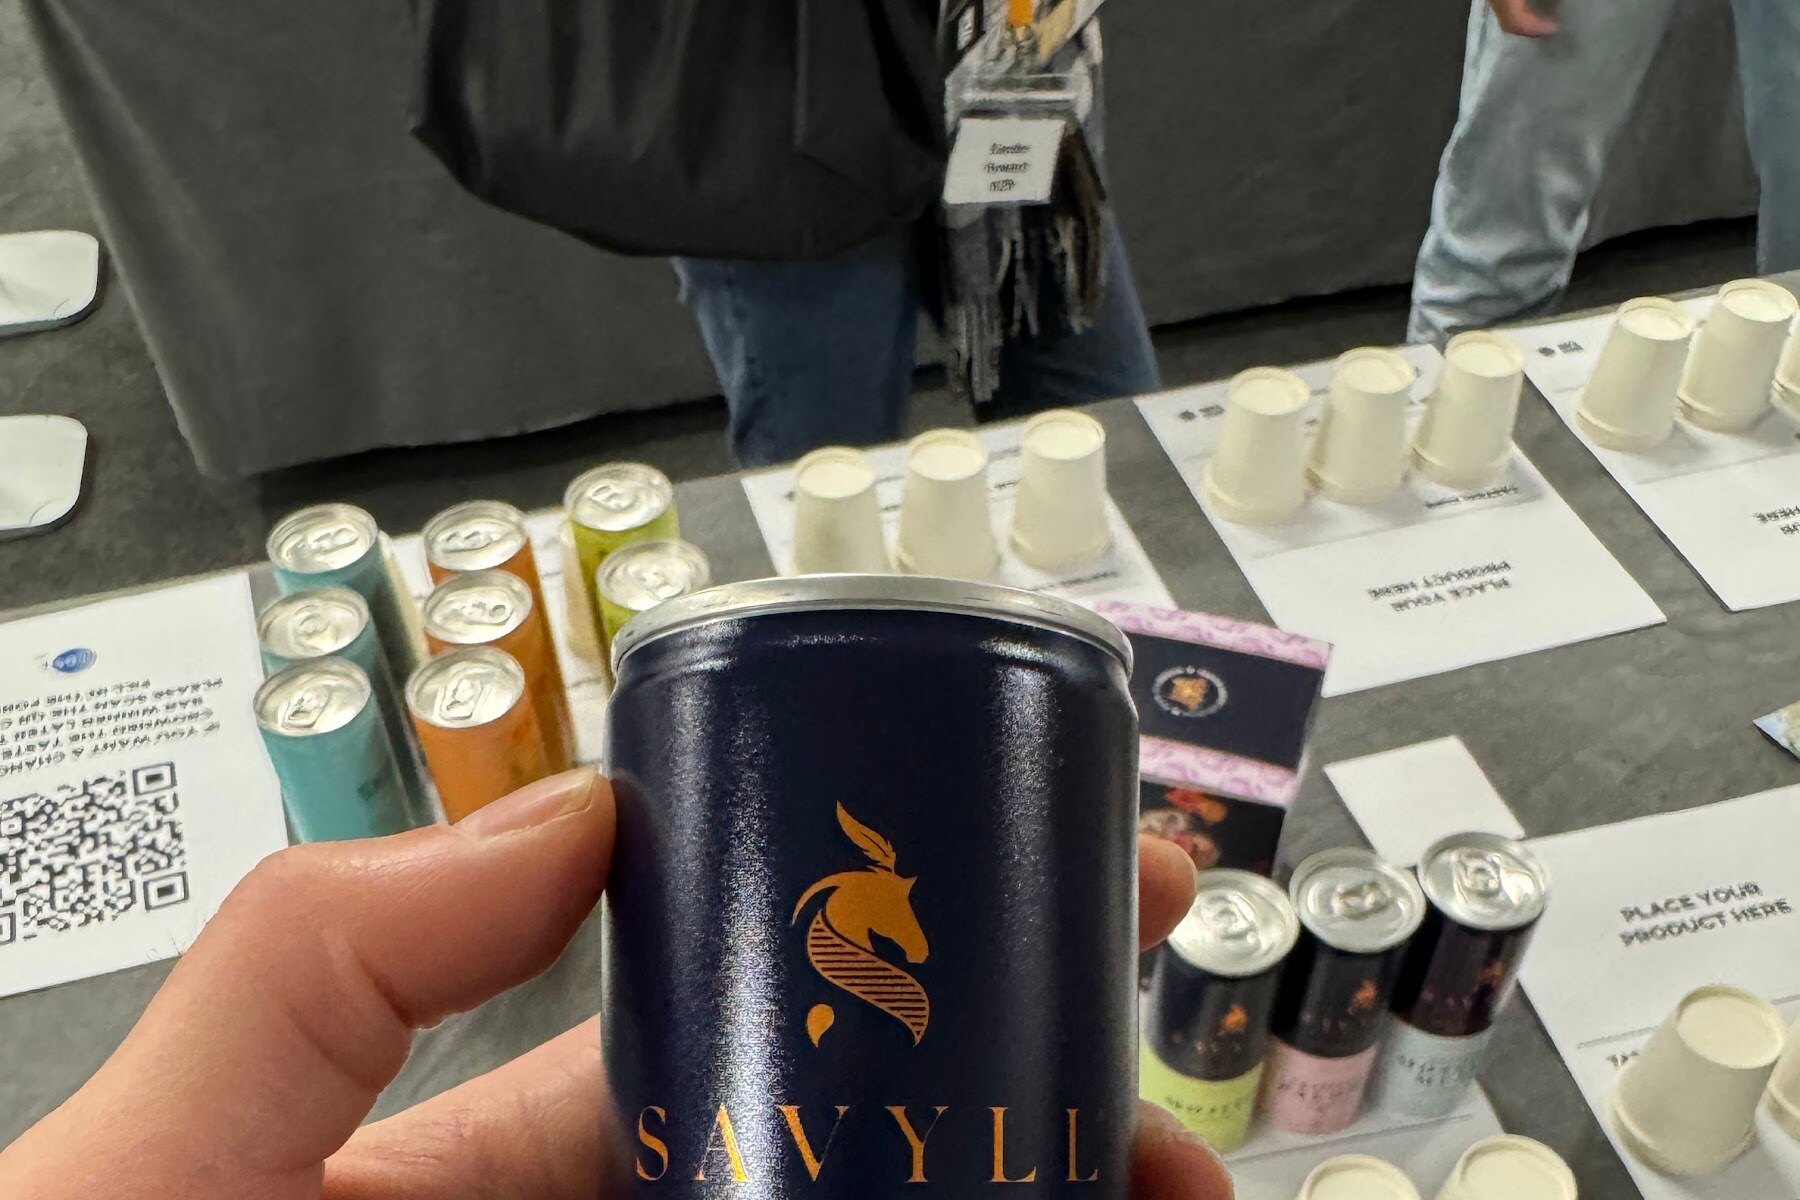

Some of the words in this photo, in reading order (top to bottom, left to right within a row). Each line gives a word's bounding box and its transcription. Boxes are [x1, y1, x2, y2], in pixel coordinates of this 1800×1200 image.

[1619, 911, 1726, 948] PRODUCT
[1729, 896, 1792, 923] HERE
[1620, 896, 1696, 923] PLACE
[1696, 880, 1763, 905] YOUR
[635, 1103, 1099, 1184] SAVYLL
